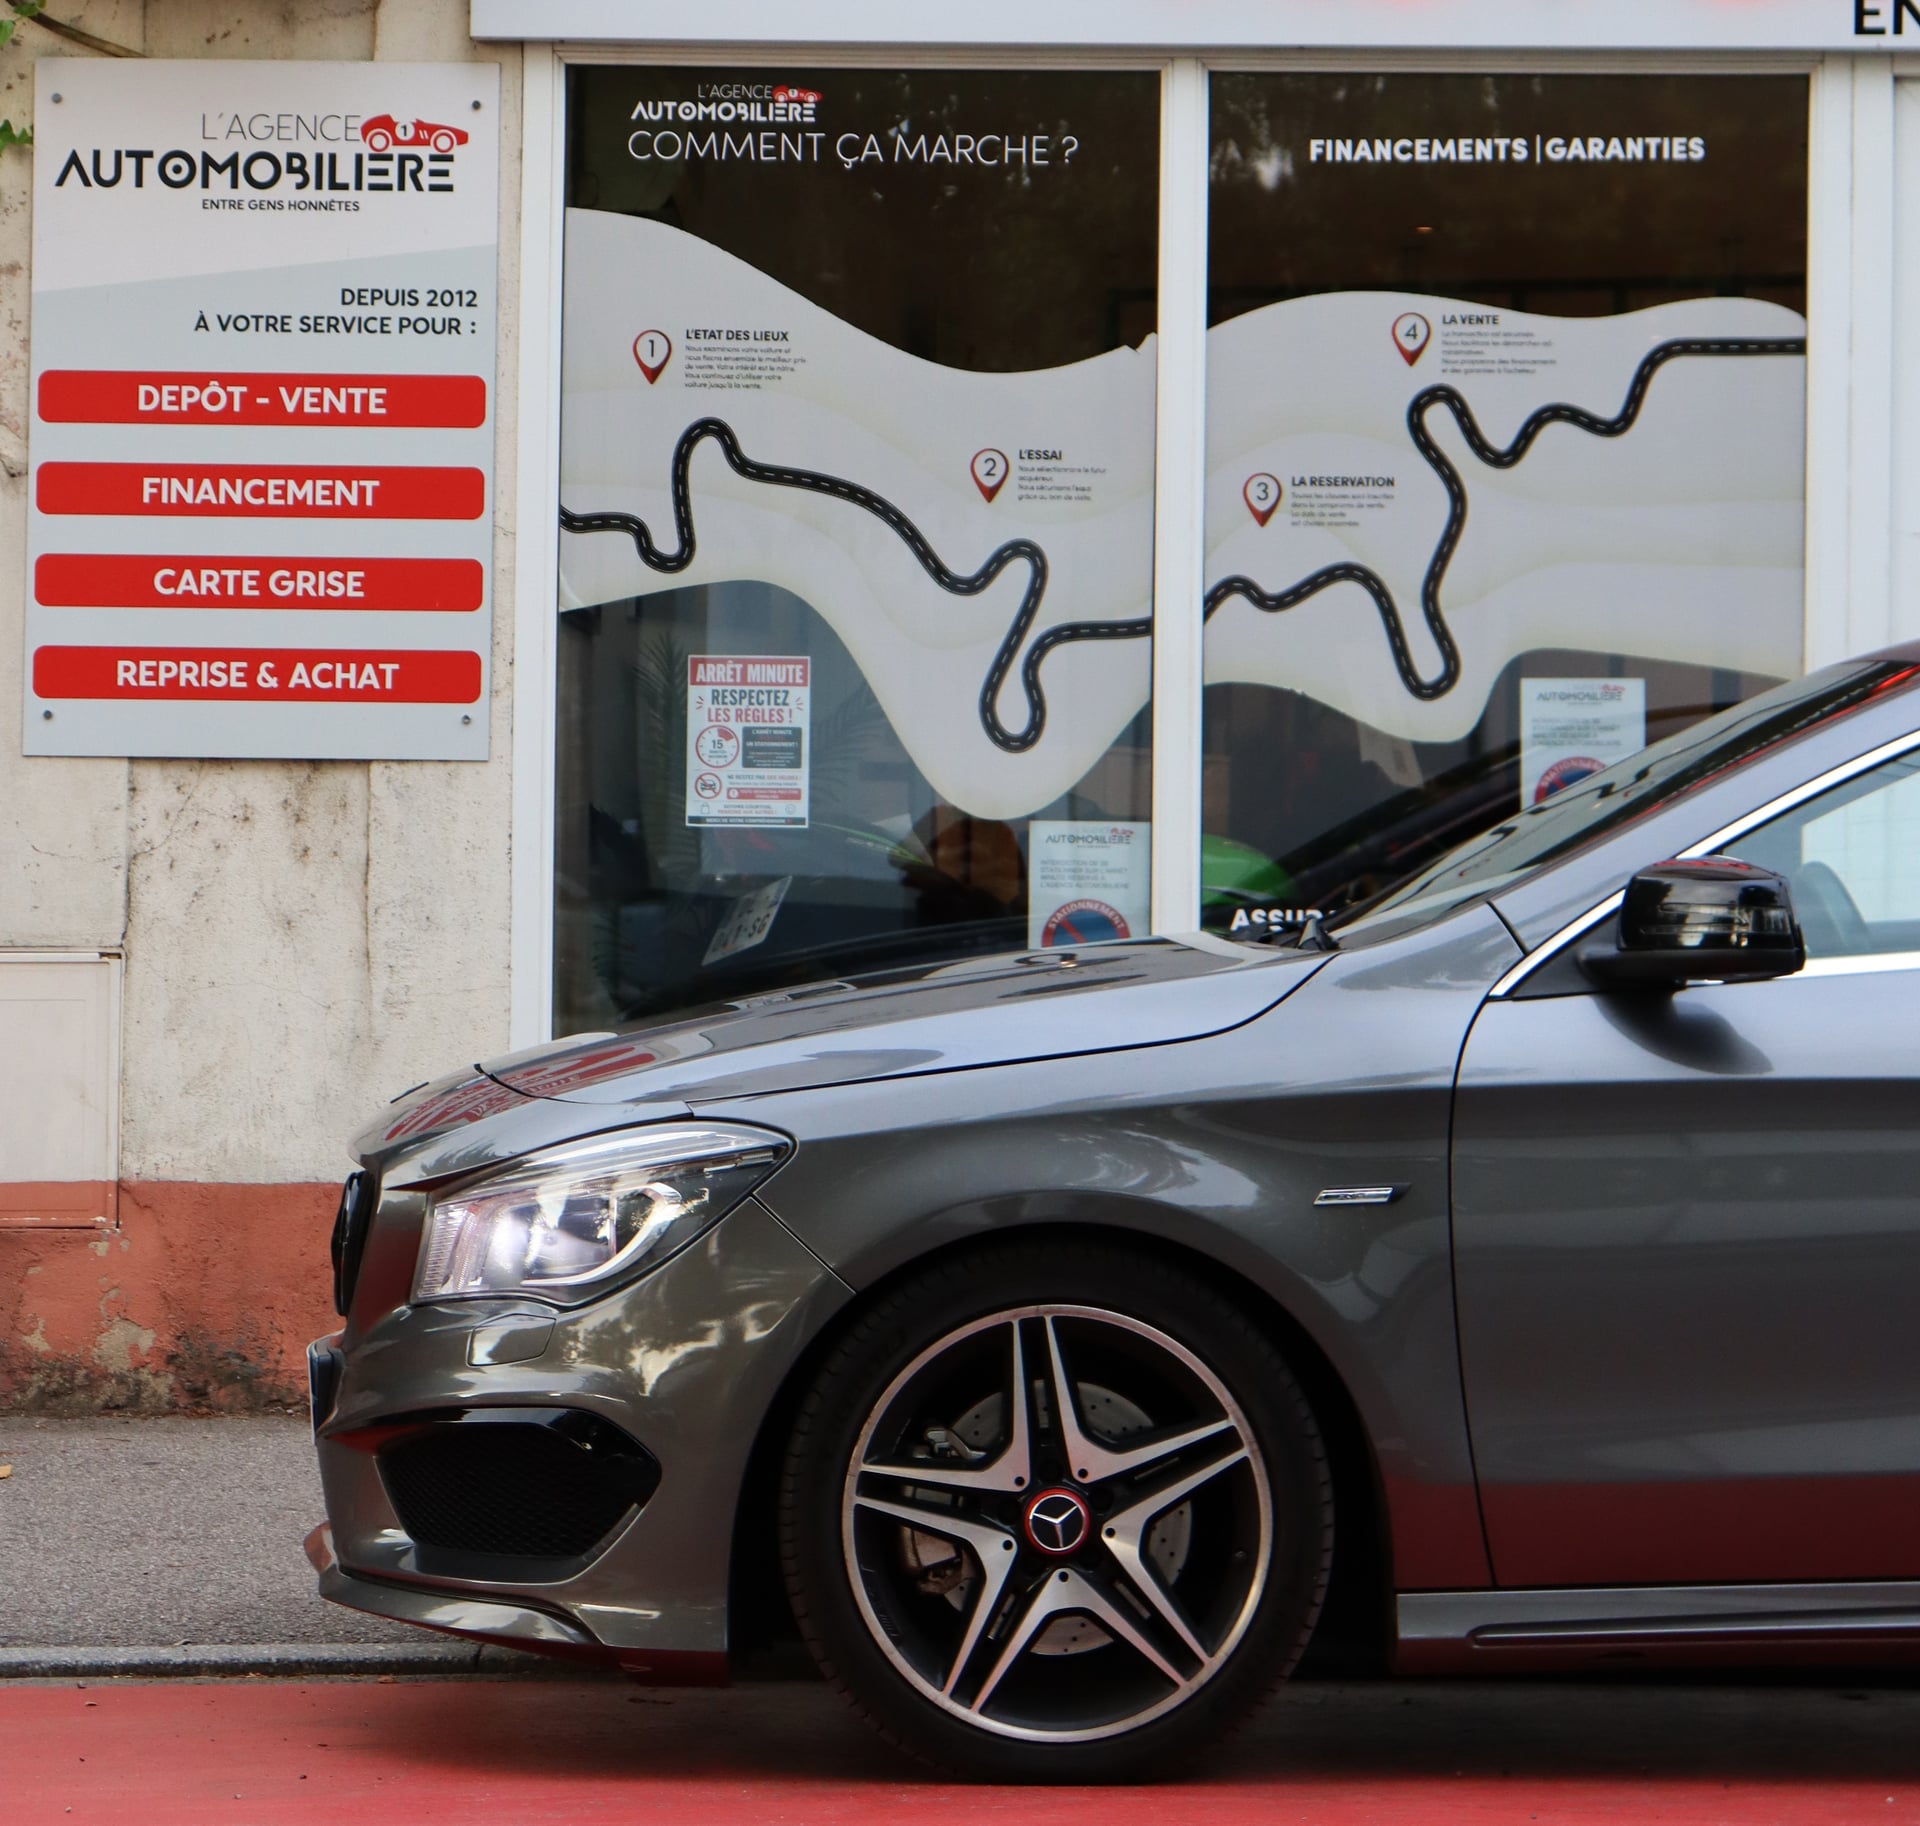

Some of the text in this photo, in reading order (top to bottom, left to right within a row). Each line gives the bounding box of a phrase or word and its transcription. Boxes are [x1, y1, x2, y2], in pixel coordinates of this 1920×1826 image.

[697, 84, 773, 99] L'AGENCE
[201, 113, 361, 142] L'AGENCE
[628, 130, 1079, 169] COMMENT ÇA MARCHE ?
[1309, 138, 1528, 162] FINANCEMENTS
[1545, 136, 1705, 161] GARANTIES
[202, 198, 360, 212] ENTRE GENS HONNÊTES
[341, 288, 478, 308] DEPUIS 2012
[194, 310, 209, 332] À
[216, 314, 292, 333] VOTRE
[299, 315, 392, 334] SERVICE
[398, 316, 462, 335] POUR
[1442, 315, 1500, 325] LA VENTE
[686, 329, 789, 342] L'ETAT DES LIEUX
[1405, 322, 1418, 340] 4
[648, 339, 655, 358] 1
[138, 380, 247, 412] DEPÔT
[278, 386, 387, 414] VENTE
[1019, 449, 1062, 460] L'ESSAI
[984, 457, 997, 476] 2
[1256, 481, 1269, 501] 3
[1292, 476, 1395, 487] LA RESERVATION
[142, 477, 380, 507] FINANCEMENT
[153, 568, 365, 598] CARTE GRISE
[116, 660, 400, 690] REPRISE & ACHAT
[696, 660, 804, 683] ARRÊT MINUTE
[711, 689, 790, 706] RESPECTEZ
[707, 707, 731, 722] LES
[711, 739, 724, 750] 15
[1048, 901, 1125, 929] STATIONNEMENT
